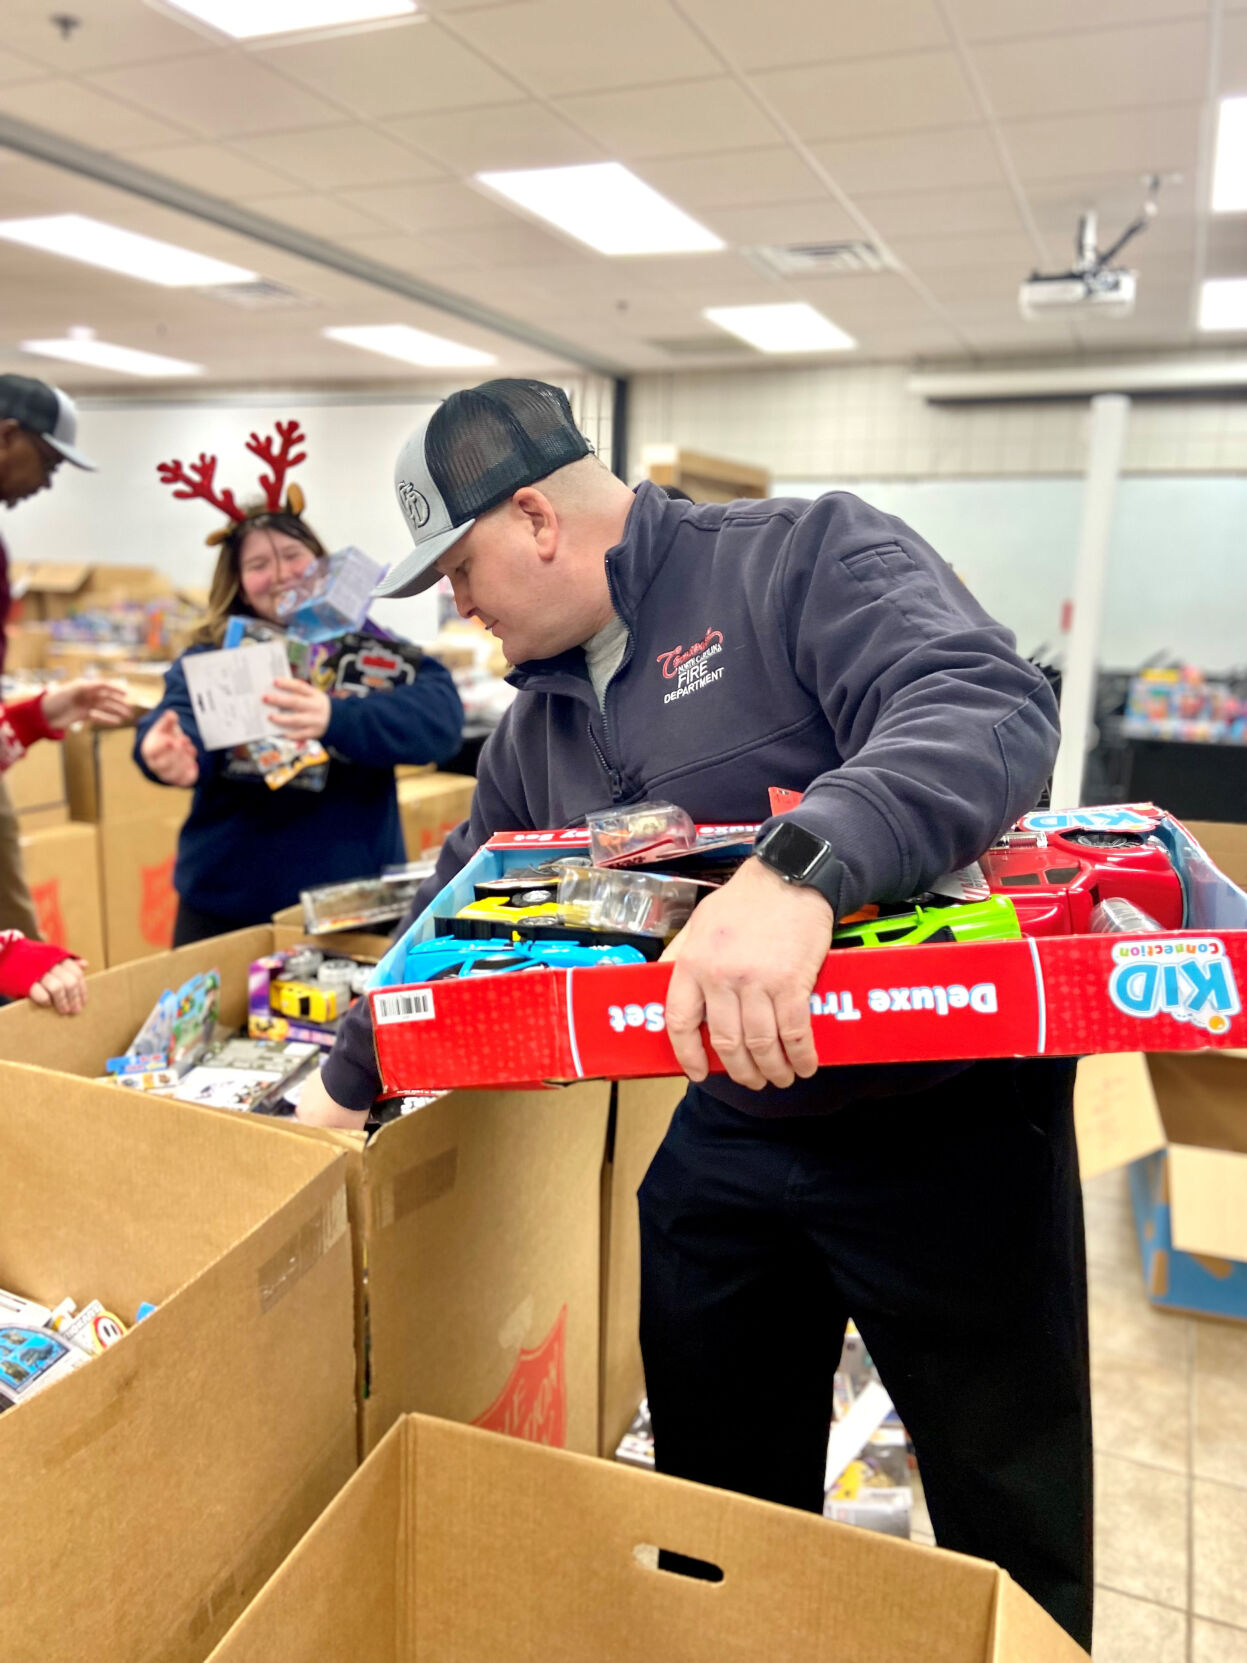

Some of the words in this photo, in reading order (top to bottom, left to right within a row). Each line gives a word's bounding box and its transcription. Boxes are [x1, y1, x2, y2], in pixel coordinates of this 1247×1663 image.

[664, 666, 724, 704] DEPARTMENT
[677, 660, 709, 689] FIRE
[1029, 812, 1147, 829] KID
[867, 983, 998, 1015] Deluxe
[1115, 960, 1233, 1012] KID
[608, 1002, 665, 1032] Set
[809, 990, 862, 1021] Tru
